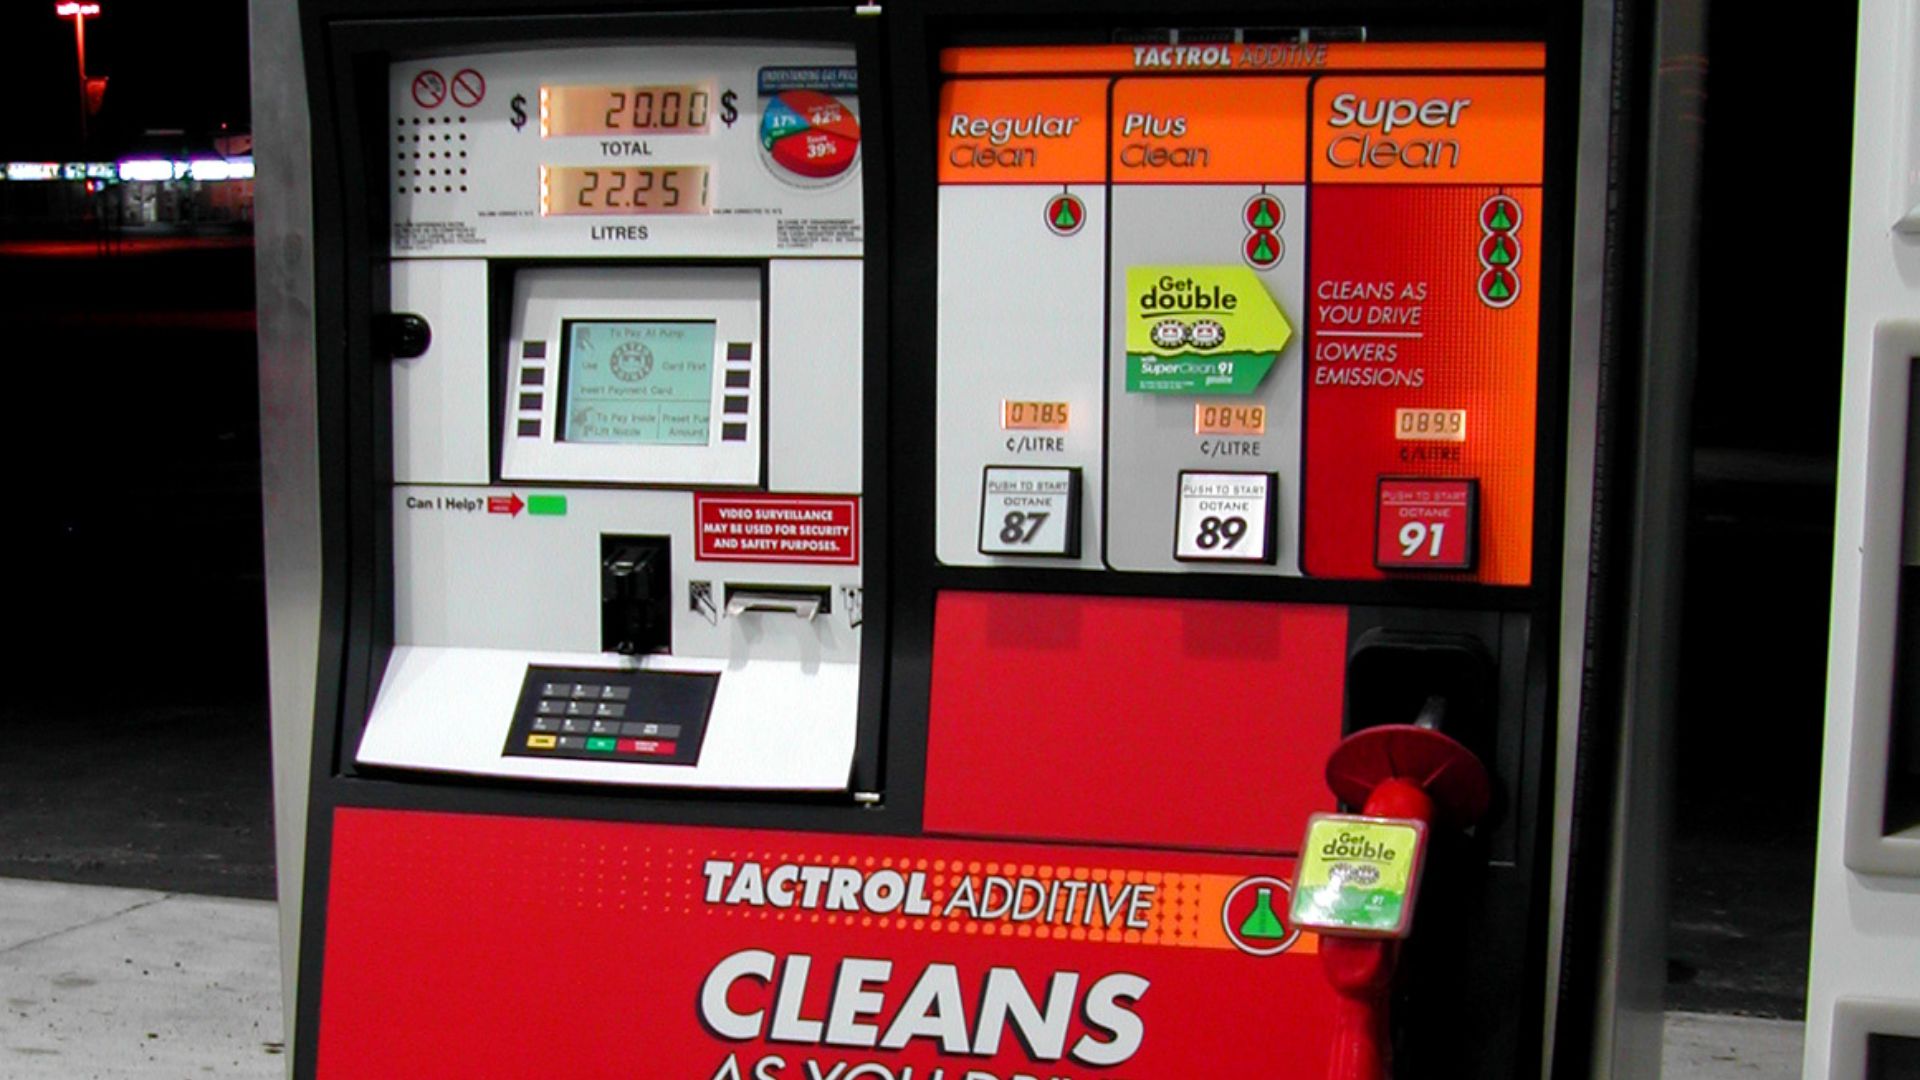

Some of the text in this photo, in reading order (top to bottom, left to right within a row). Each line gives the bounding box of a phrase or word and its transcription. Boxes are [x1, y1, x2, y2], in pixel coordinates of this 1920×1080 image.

[1133, 44, 1327, 66] TACTROL ADDITIVE
[606, 92, 708, 127] 20.00
[811, 111, 842, 125] 42%
[1329, 94, 1472, 132] Super
[949, 114, 1079, 144] Regular
[1122, 114, 1188, 138] Plus
[601, 141, 652, 155] TOTAL
[808, 142, 836, 158] 39%
[949, 143, 1038, 168] Clean
[1119, 144, 1210, 168] Clean
[1327, 132, 1461, 169] Clean
[591, 226, 648, 239] LITRES
[1159, 275, 1193, 291] Get
[1317, 280, 1427, 301] CLEANS AS
[1140, 285, 1238, 309] double
[1318, 305, 1422, 325] YOU DRIVE
[1315, 342, 1397, 362] LOWERS
[1217, 361, 1234, 376] 91
[1315, 366, 1424, 387] EMISSIONS
[1011, 402, 1067, 423] 078.5
[1204, 406, 1263, 428] 084.9
[1401, 412, 1461, 433] 089.9
[989, 481, 1068, 491] PUSH TO START
[1184, 485, 1264, 495] PUSH TO START
[1383, 490, 1467, 500] PUSH TO START
[406, 497, 433, 509] Can
[446, 498, 483, 512] Help?
[1003, 497, 1051, 507] OCTANE
[1199, 502, 1249, 511] OCTANE
[1399, 507, 1450, 517] OCTANE
[719, 508, 833, 521] VIDEO SURVEILLANCE
[704, 523, 849, 536] MAY BE USED FOR SECURITY
[999, 511, 1050, 543] 87
[1196, 516, 1247, 550] 89
[714, 538, 840, 551] AND SAFETY PURPOSES.
[1398, 521, 1445, 557] 91
[1339, 831, 1365, 844] Get
[1322, 838, 1396, 860] double
[703, 860, 1155, 928] TACTROL ADDITIVE
[699, 949, 1152, 1065] CLEANS
